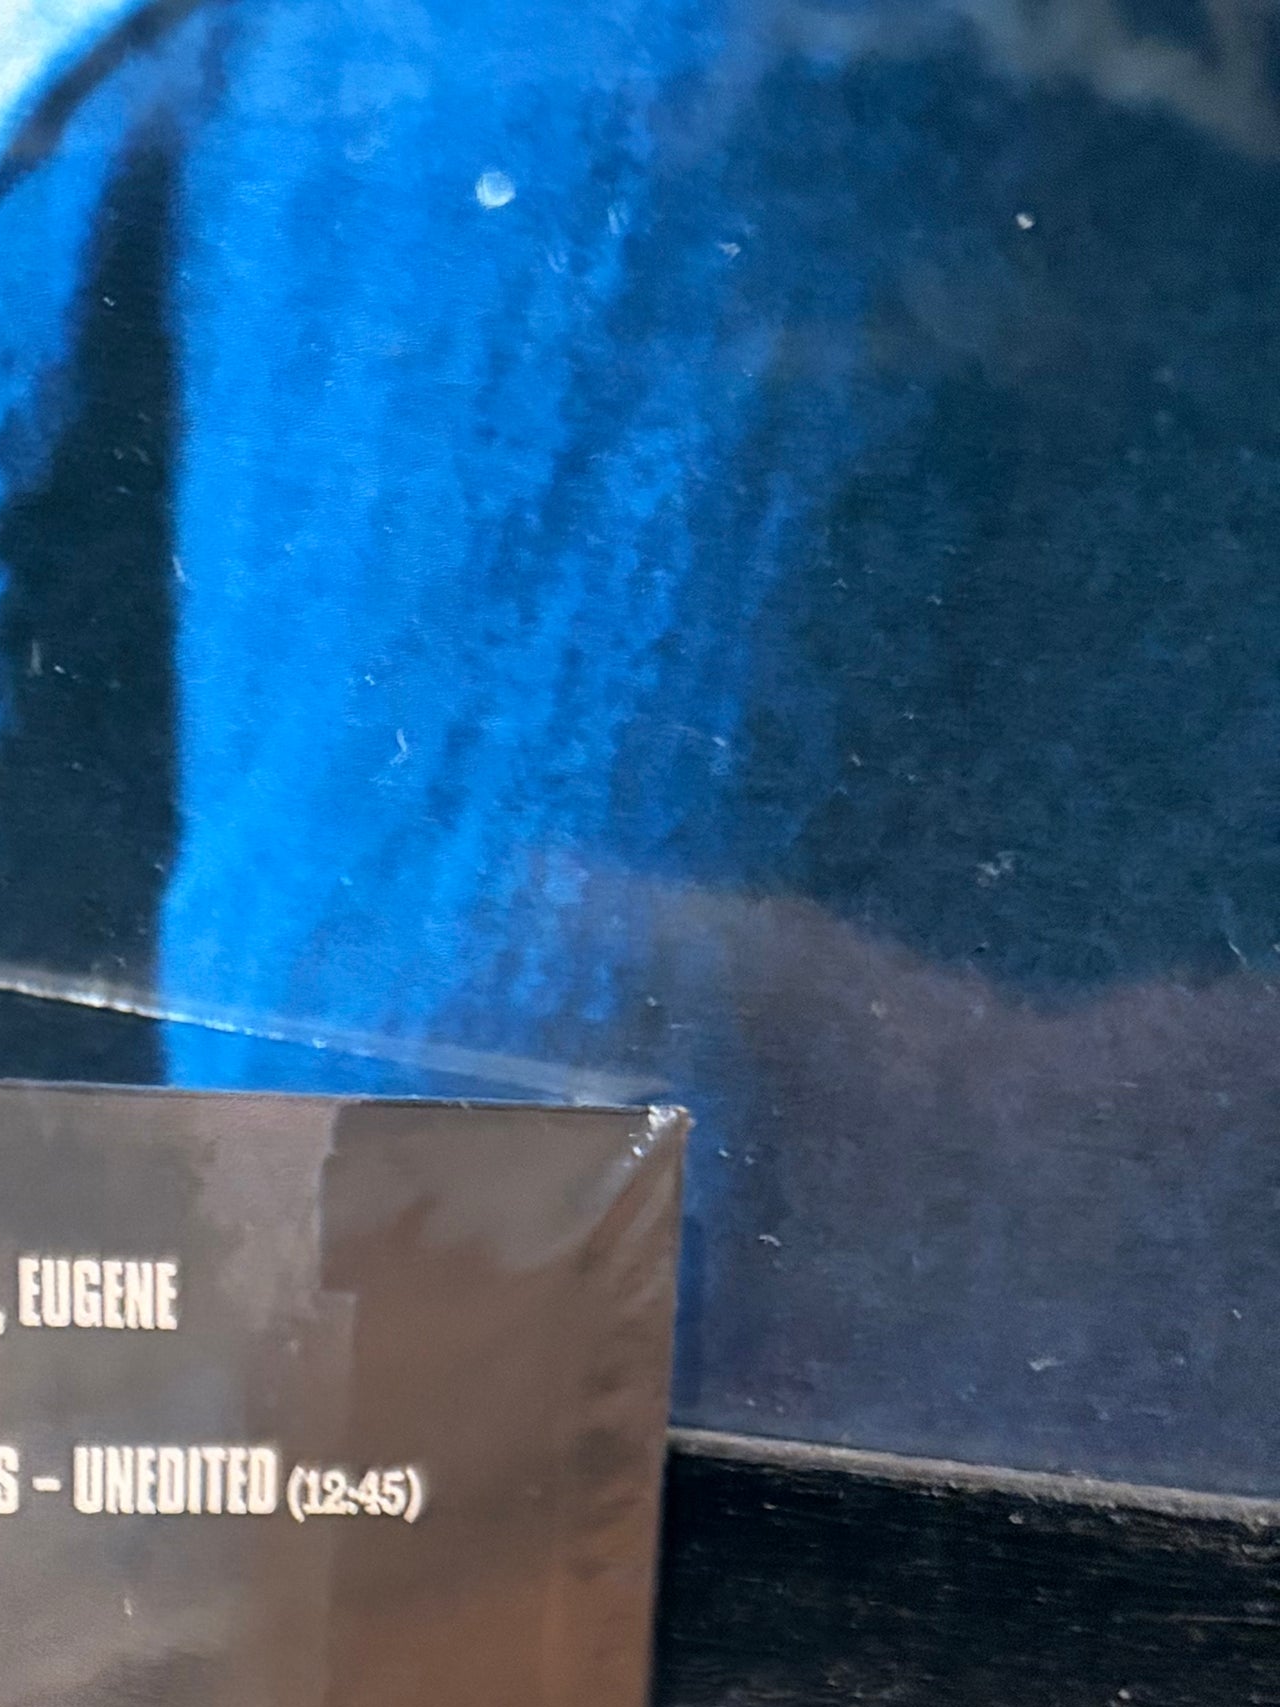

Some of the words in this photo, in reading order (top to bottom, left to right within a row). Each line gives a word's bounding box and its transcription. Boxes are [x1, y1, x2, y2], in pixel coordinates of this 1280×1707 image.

[20, 1259, 176, 1329] EUGENE
[75, 1447, 276, 1513] UNEDITED
[288, 1466, 422, 1522] (12:45)
